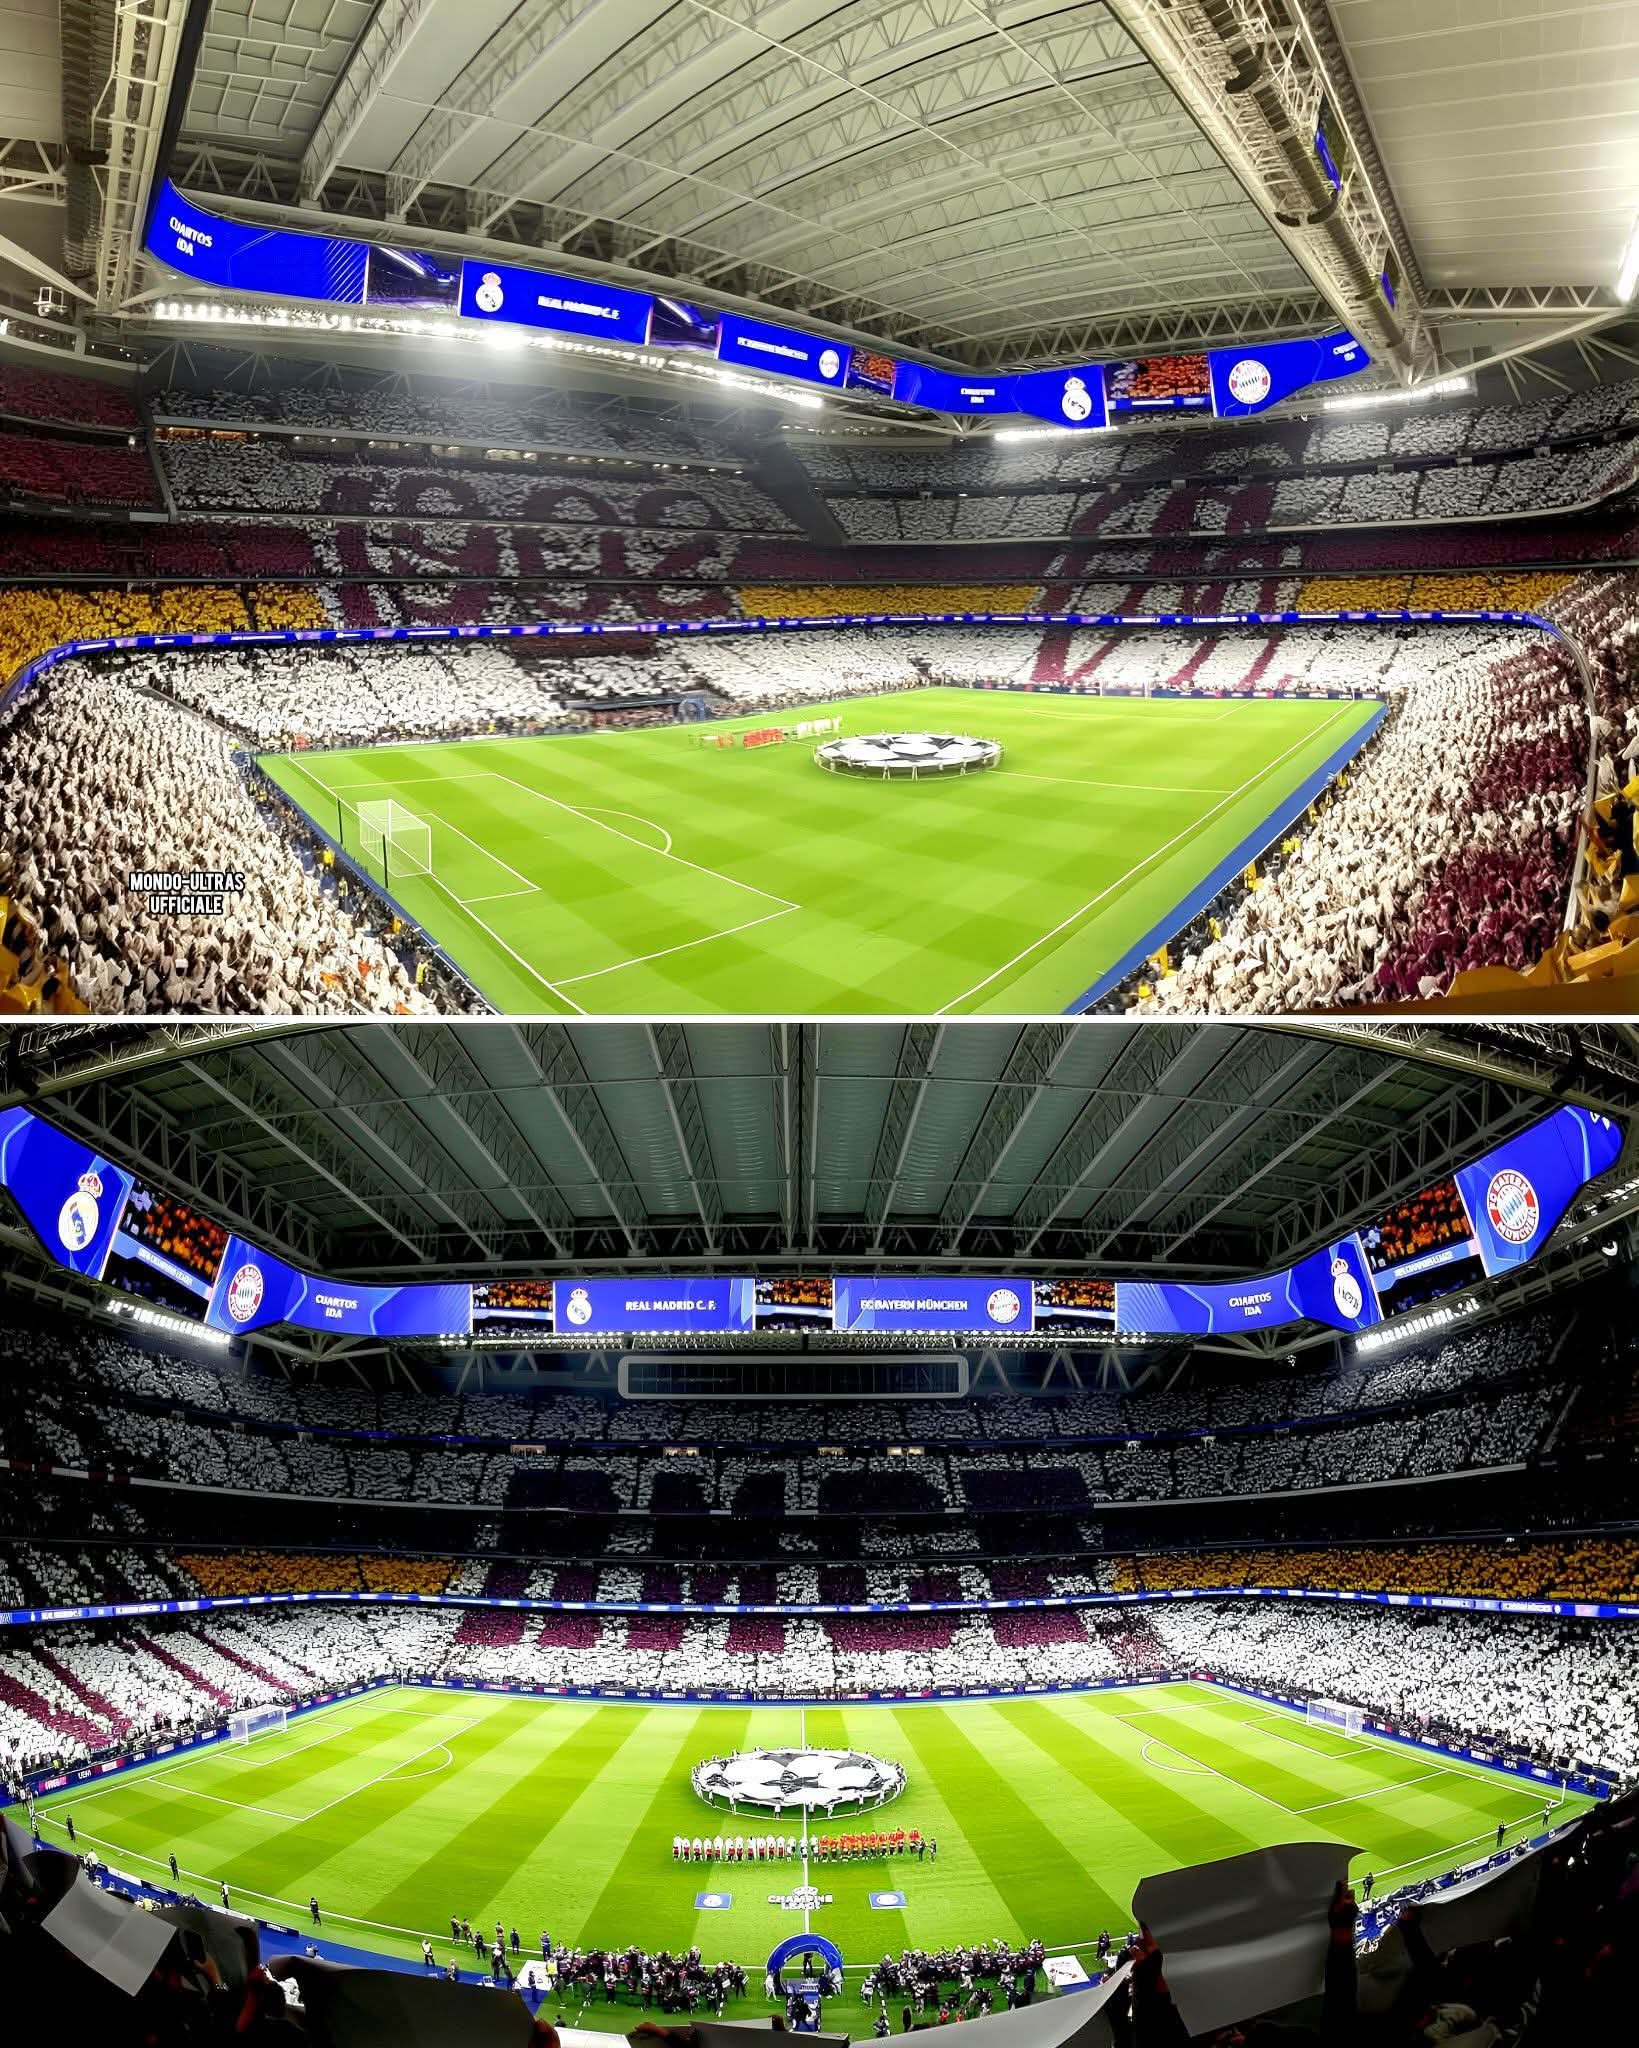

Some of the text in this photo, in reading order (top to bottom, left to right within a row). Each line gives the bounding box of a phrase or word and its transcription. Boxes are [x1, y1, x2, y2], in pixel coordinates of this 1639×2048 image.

[315, 1294, 358, 1310] CUARTOS
[625, 1300, 651, 1311] REAL
[653, 1300, 694, 1311] MADRID
[874, 1300, 915, 1311] BAYERN
[916, 1298, 968, 1311] MÜNCHEN
[325, 1307, 342, 1319] IDA
[1244, 1305, 1262, 1317] IDA
